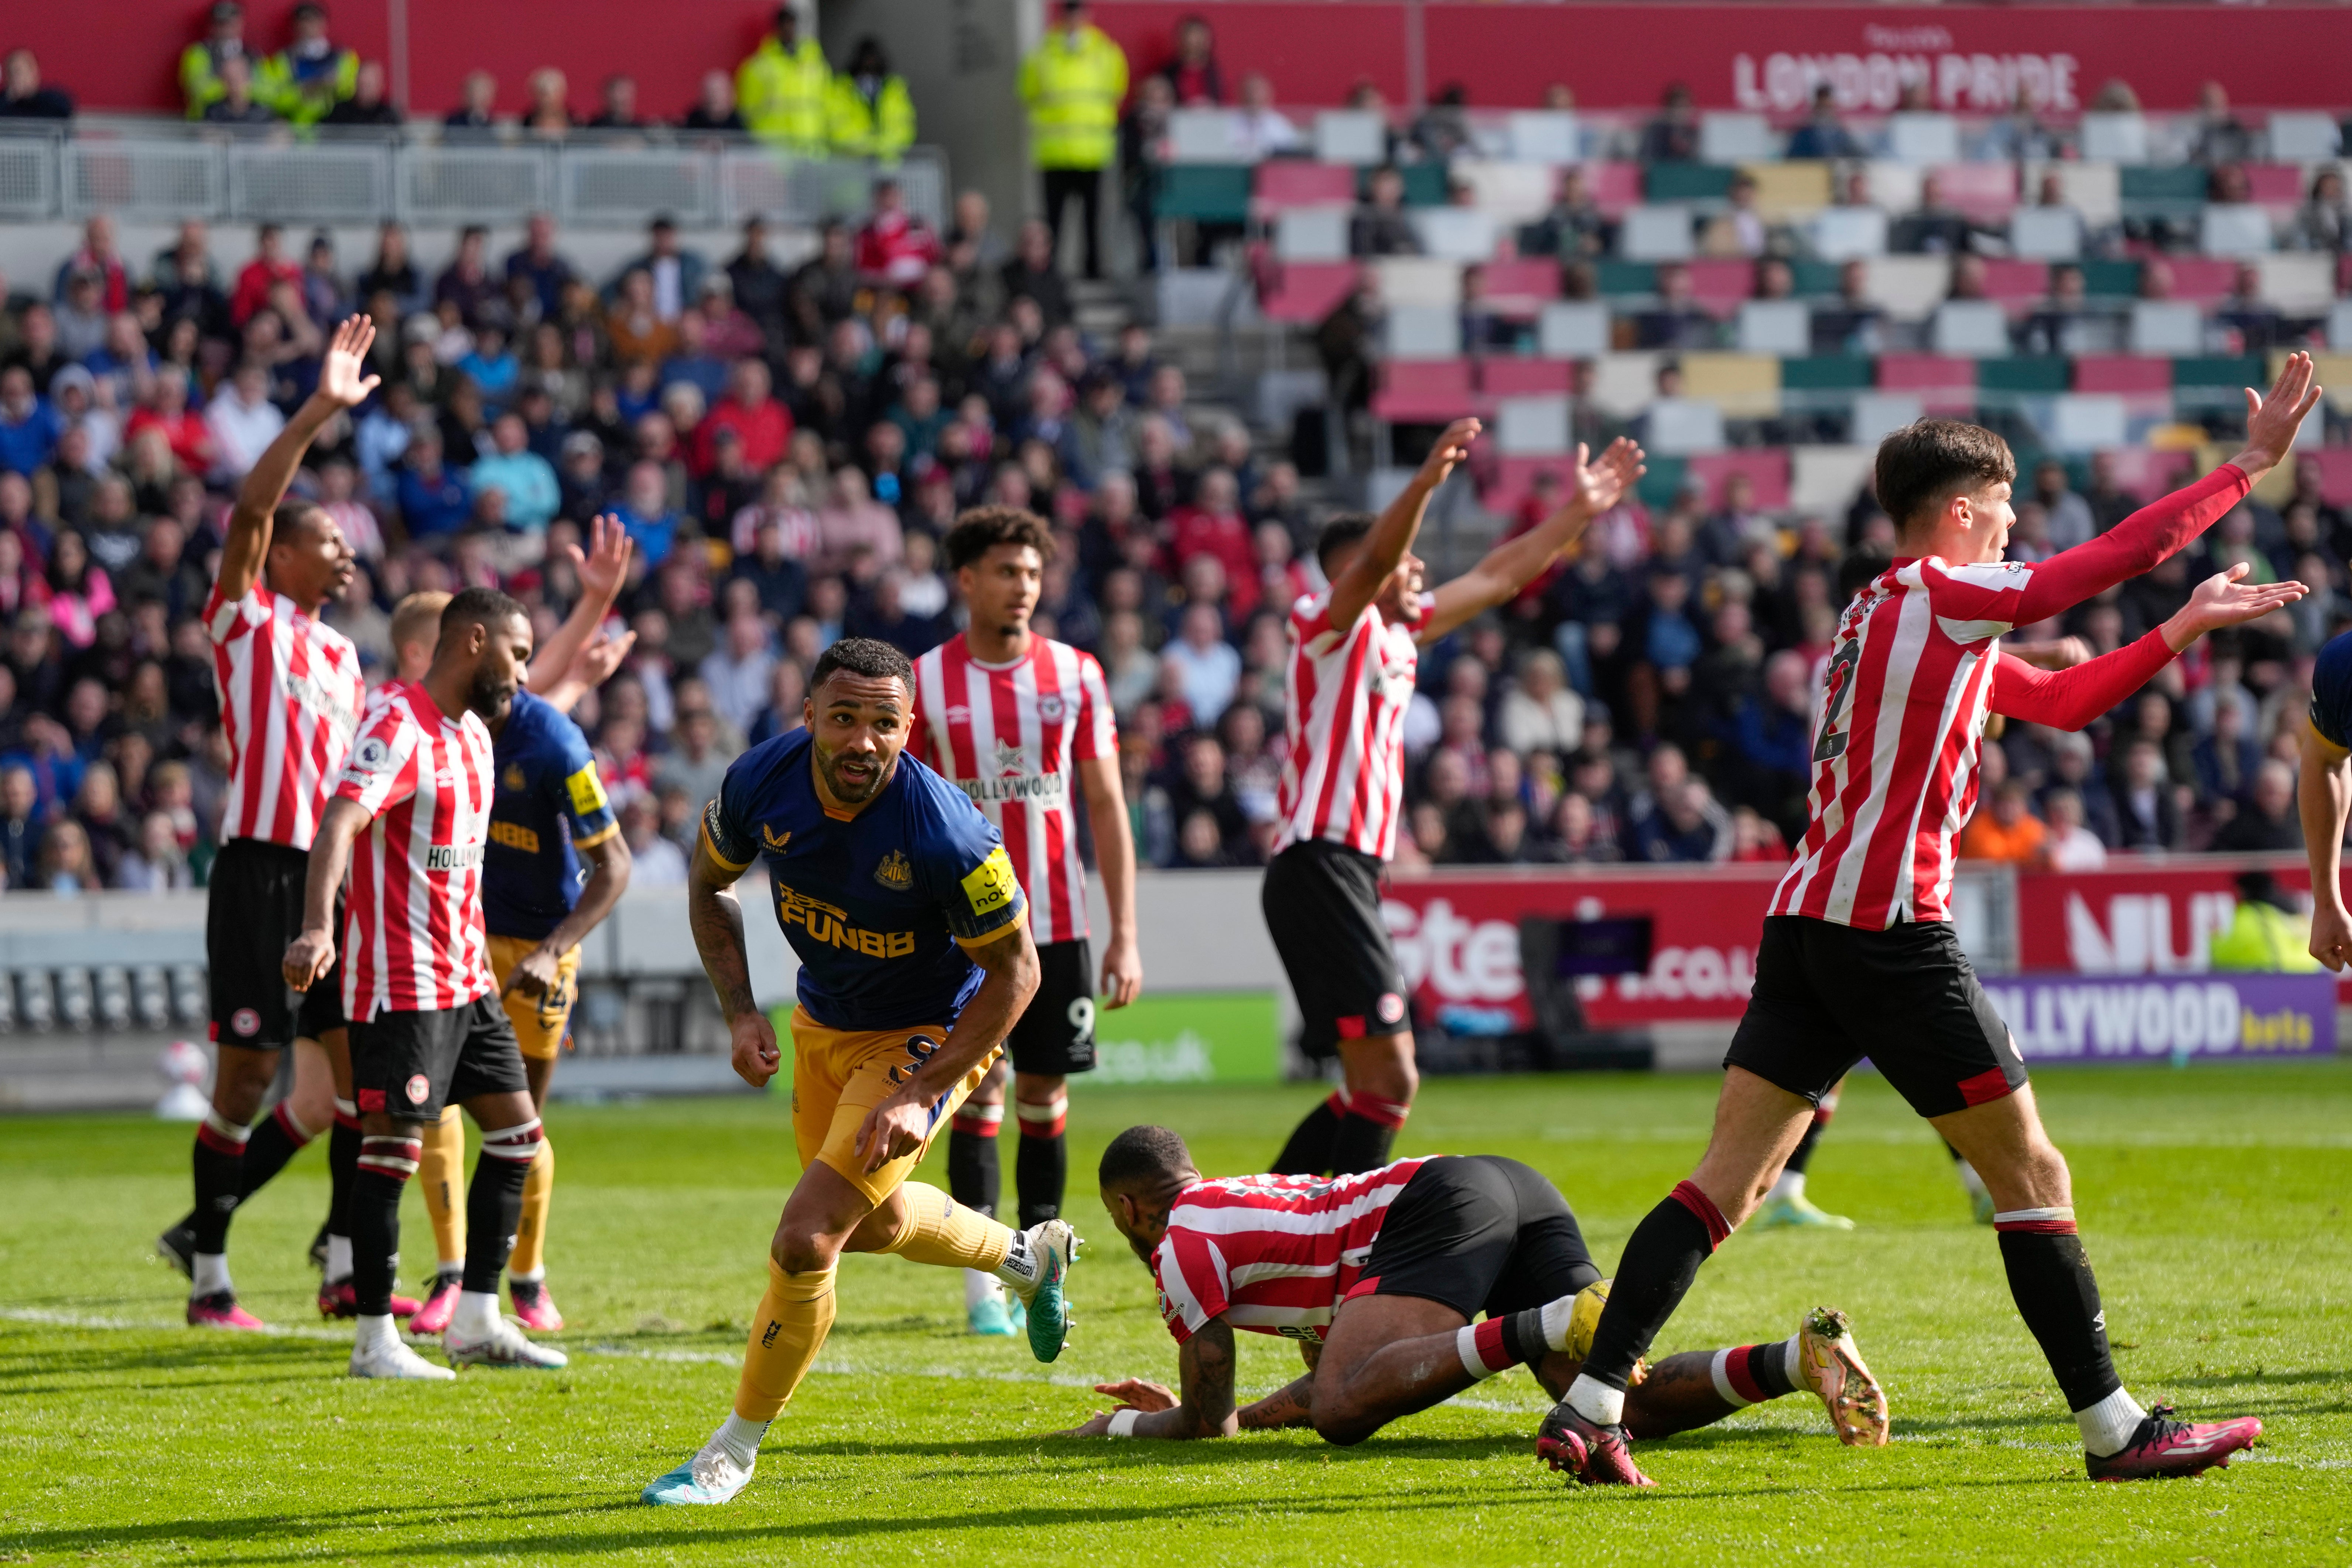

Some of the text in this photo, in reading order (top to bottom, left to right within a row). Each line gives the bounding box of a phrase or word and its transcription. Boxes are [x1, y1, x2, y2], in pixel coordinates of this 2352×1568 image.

[1733, 52, 2081, 110] LONDON PRIDE
[1813, 638, 1859, 762] 2
[762, 842, 787, 855] CASTORE
[975, 874, 1013, 907] noon
[780, 901, 915, 959] FUN88
[1067, 996, 1094, 1044] 9
[2241, 1006, 2313, 1052] bets
[1002, 1256, 1035, 1277] PEDESIGN
